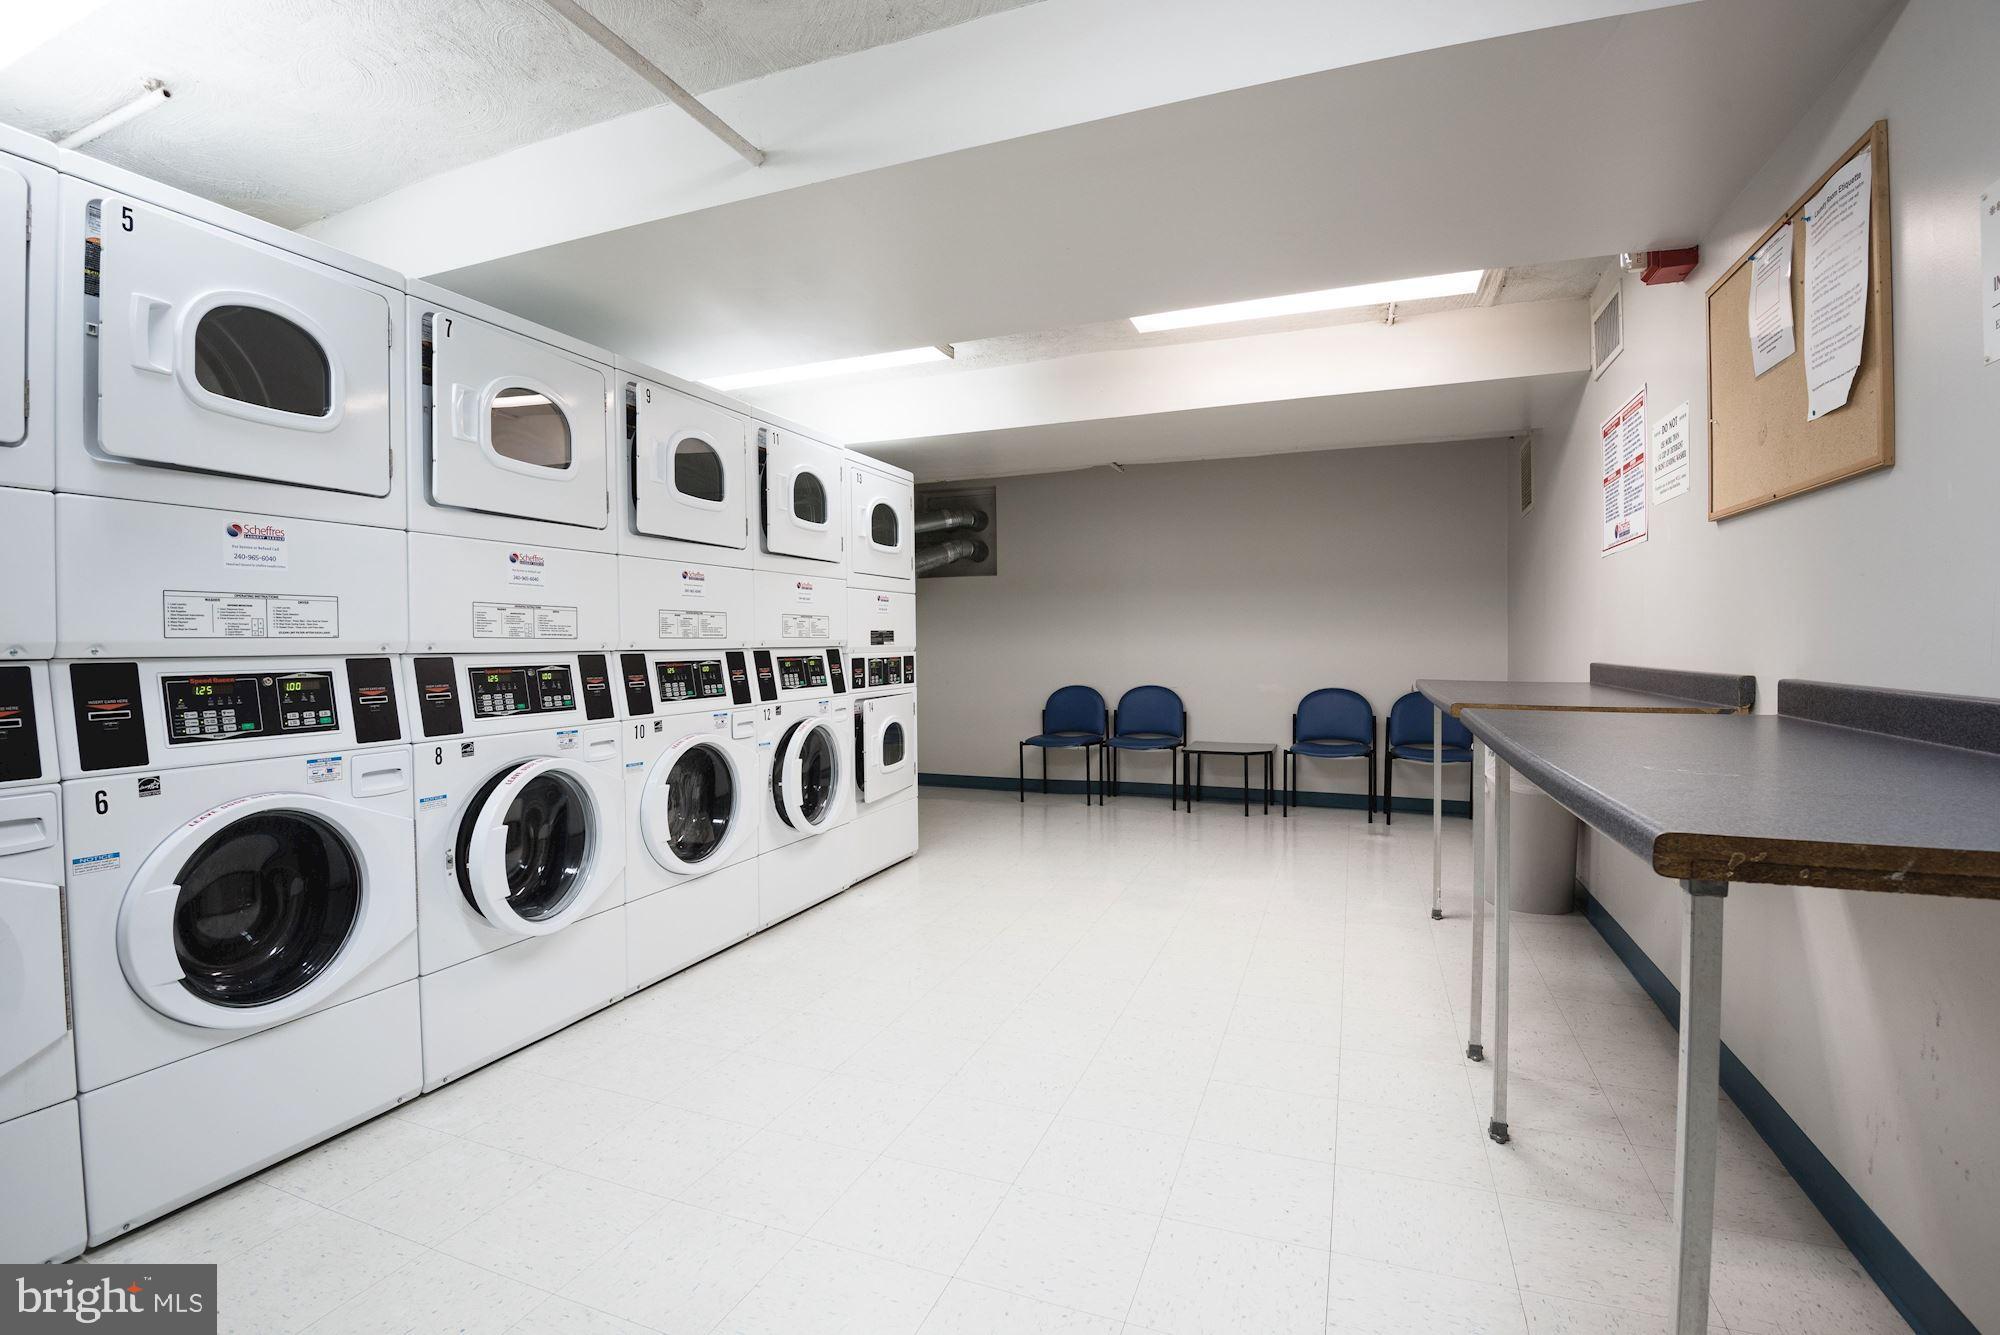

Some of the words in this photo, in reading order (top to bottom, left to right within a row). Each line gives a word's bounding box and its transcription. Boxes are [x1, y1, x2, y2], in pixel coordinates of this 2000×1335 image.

[1827, 190, 1838, 202] Room
[1838, 172, 1862, 193] Etiquette
[122, 206, 134, 232] 5
[445, 318, 452, 337] 7
[646, 388, 651, 403] 9
[1661, 423, 1669, 435] DO
[1668, 416, 1678, 429] NOT
[772, 432, 779, 445] 11
[857, 473, 862, 484] 13
[244, 524, 285, 537] Scheffres
[234, 553, 276, 562] 240-965-6040
[764, 708, 770, 720] 12
[634, 724, 645, 739] 10
[435, 746, 442, 765] 8
[506, 772, 522, 784] LEAVE
[95, 790, 108, 814] 6
[189, 810, 216, 827] LEAVE
[220, 799, 246, 809] DOOR
[80, 853, 112, 863] NOTICE
